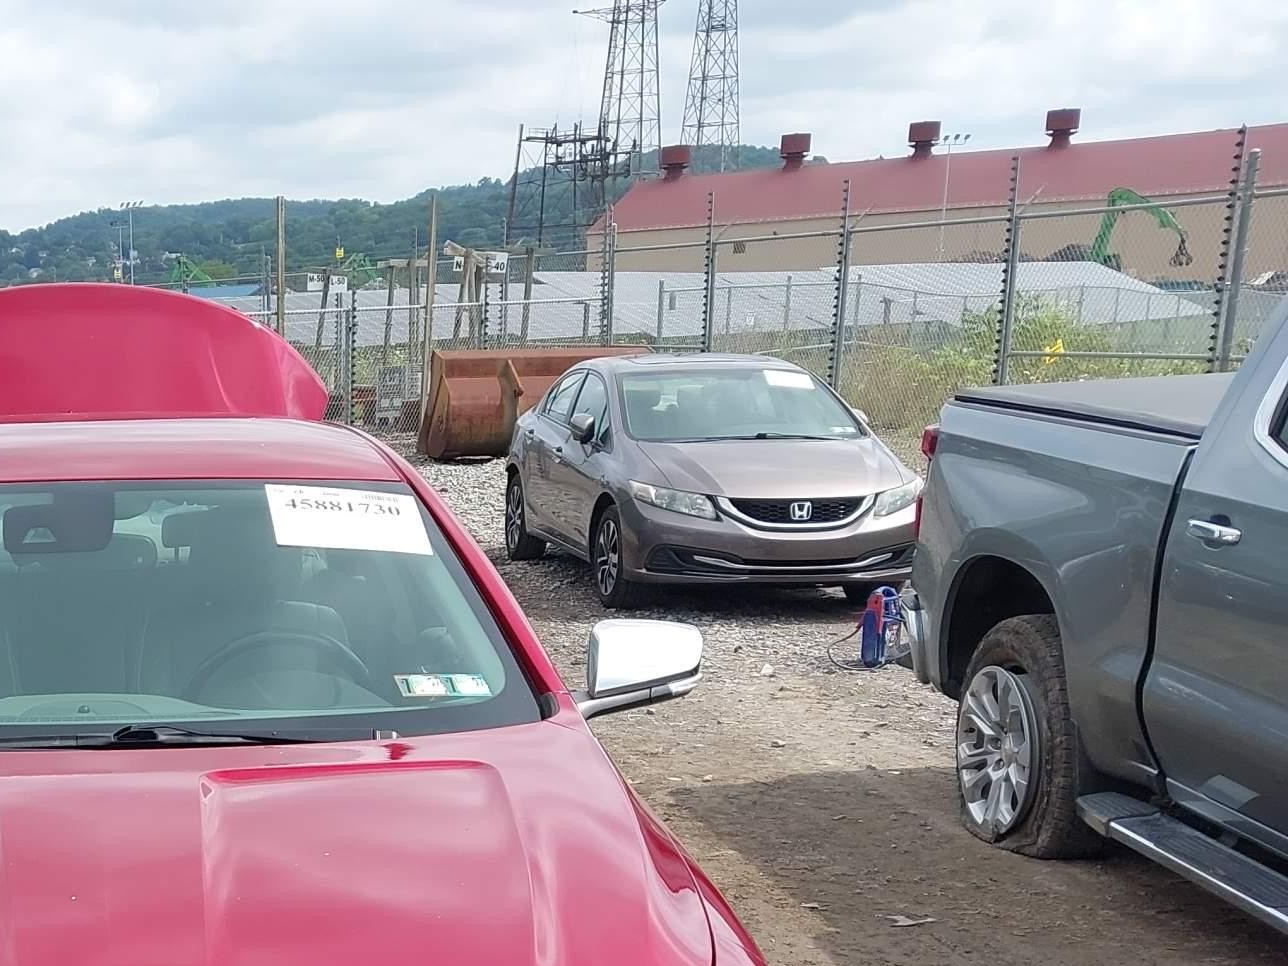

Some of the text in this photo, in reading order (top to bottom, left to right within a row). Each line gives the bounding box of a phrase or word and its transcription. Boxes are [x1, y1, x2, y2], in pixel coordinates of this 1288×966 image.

[308, 274, 325, 283] M-50
[330, 277, 346, 286] L-50
[285, 498, 401, 517] 45881730
